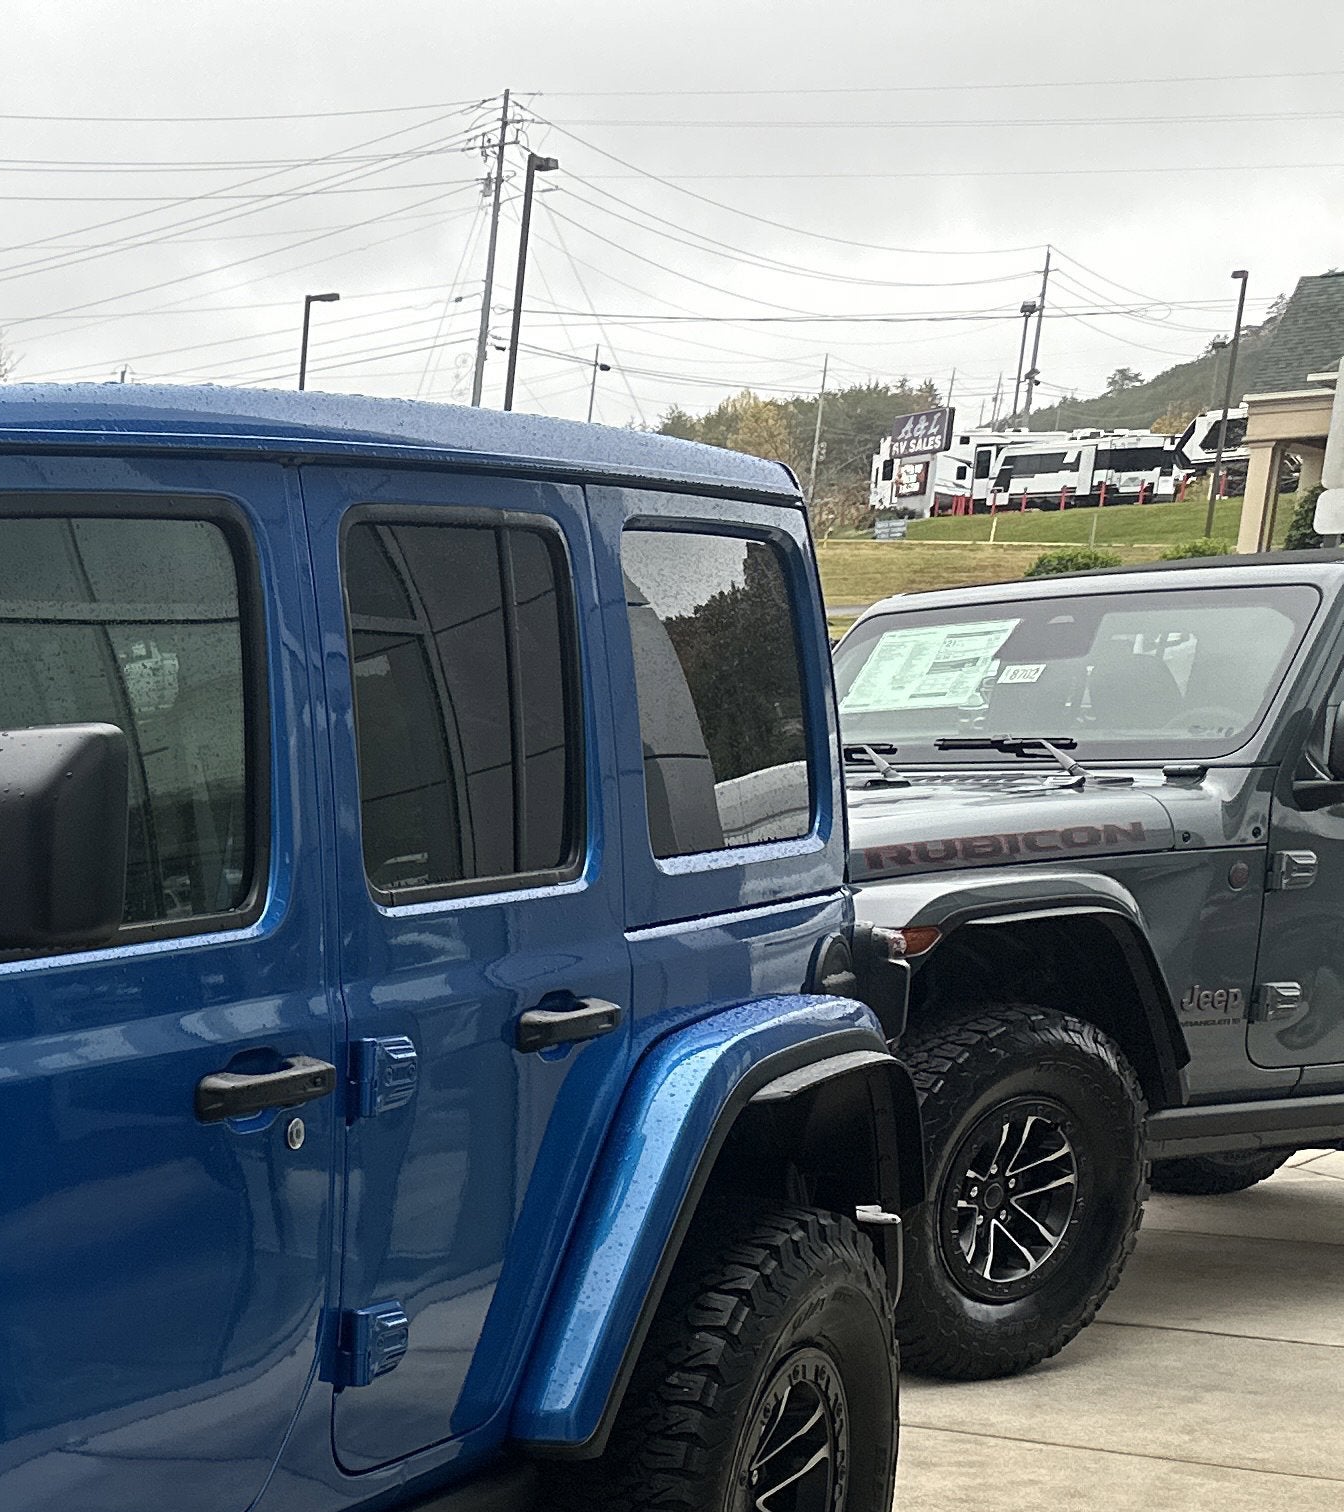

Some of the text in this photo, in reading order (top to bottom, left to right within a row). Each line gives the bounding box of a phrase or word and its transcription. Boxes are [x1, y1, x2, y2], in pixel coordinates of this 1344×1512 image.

[909, 434, 942, 453] SALES
[863, 821, 1146, 870] RUBICON
[1180, 984, 1243, 1014] Jeep
